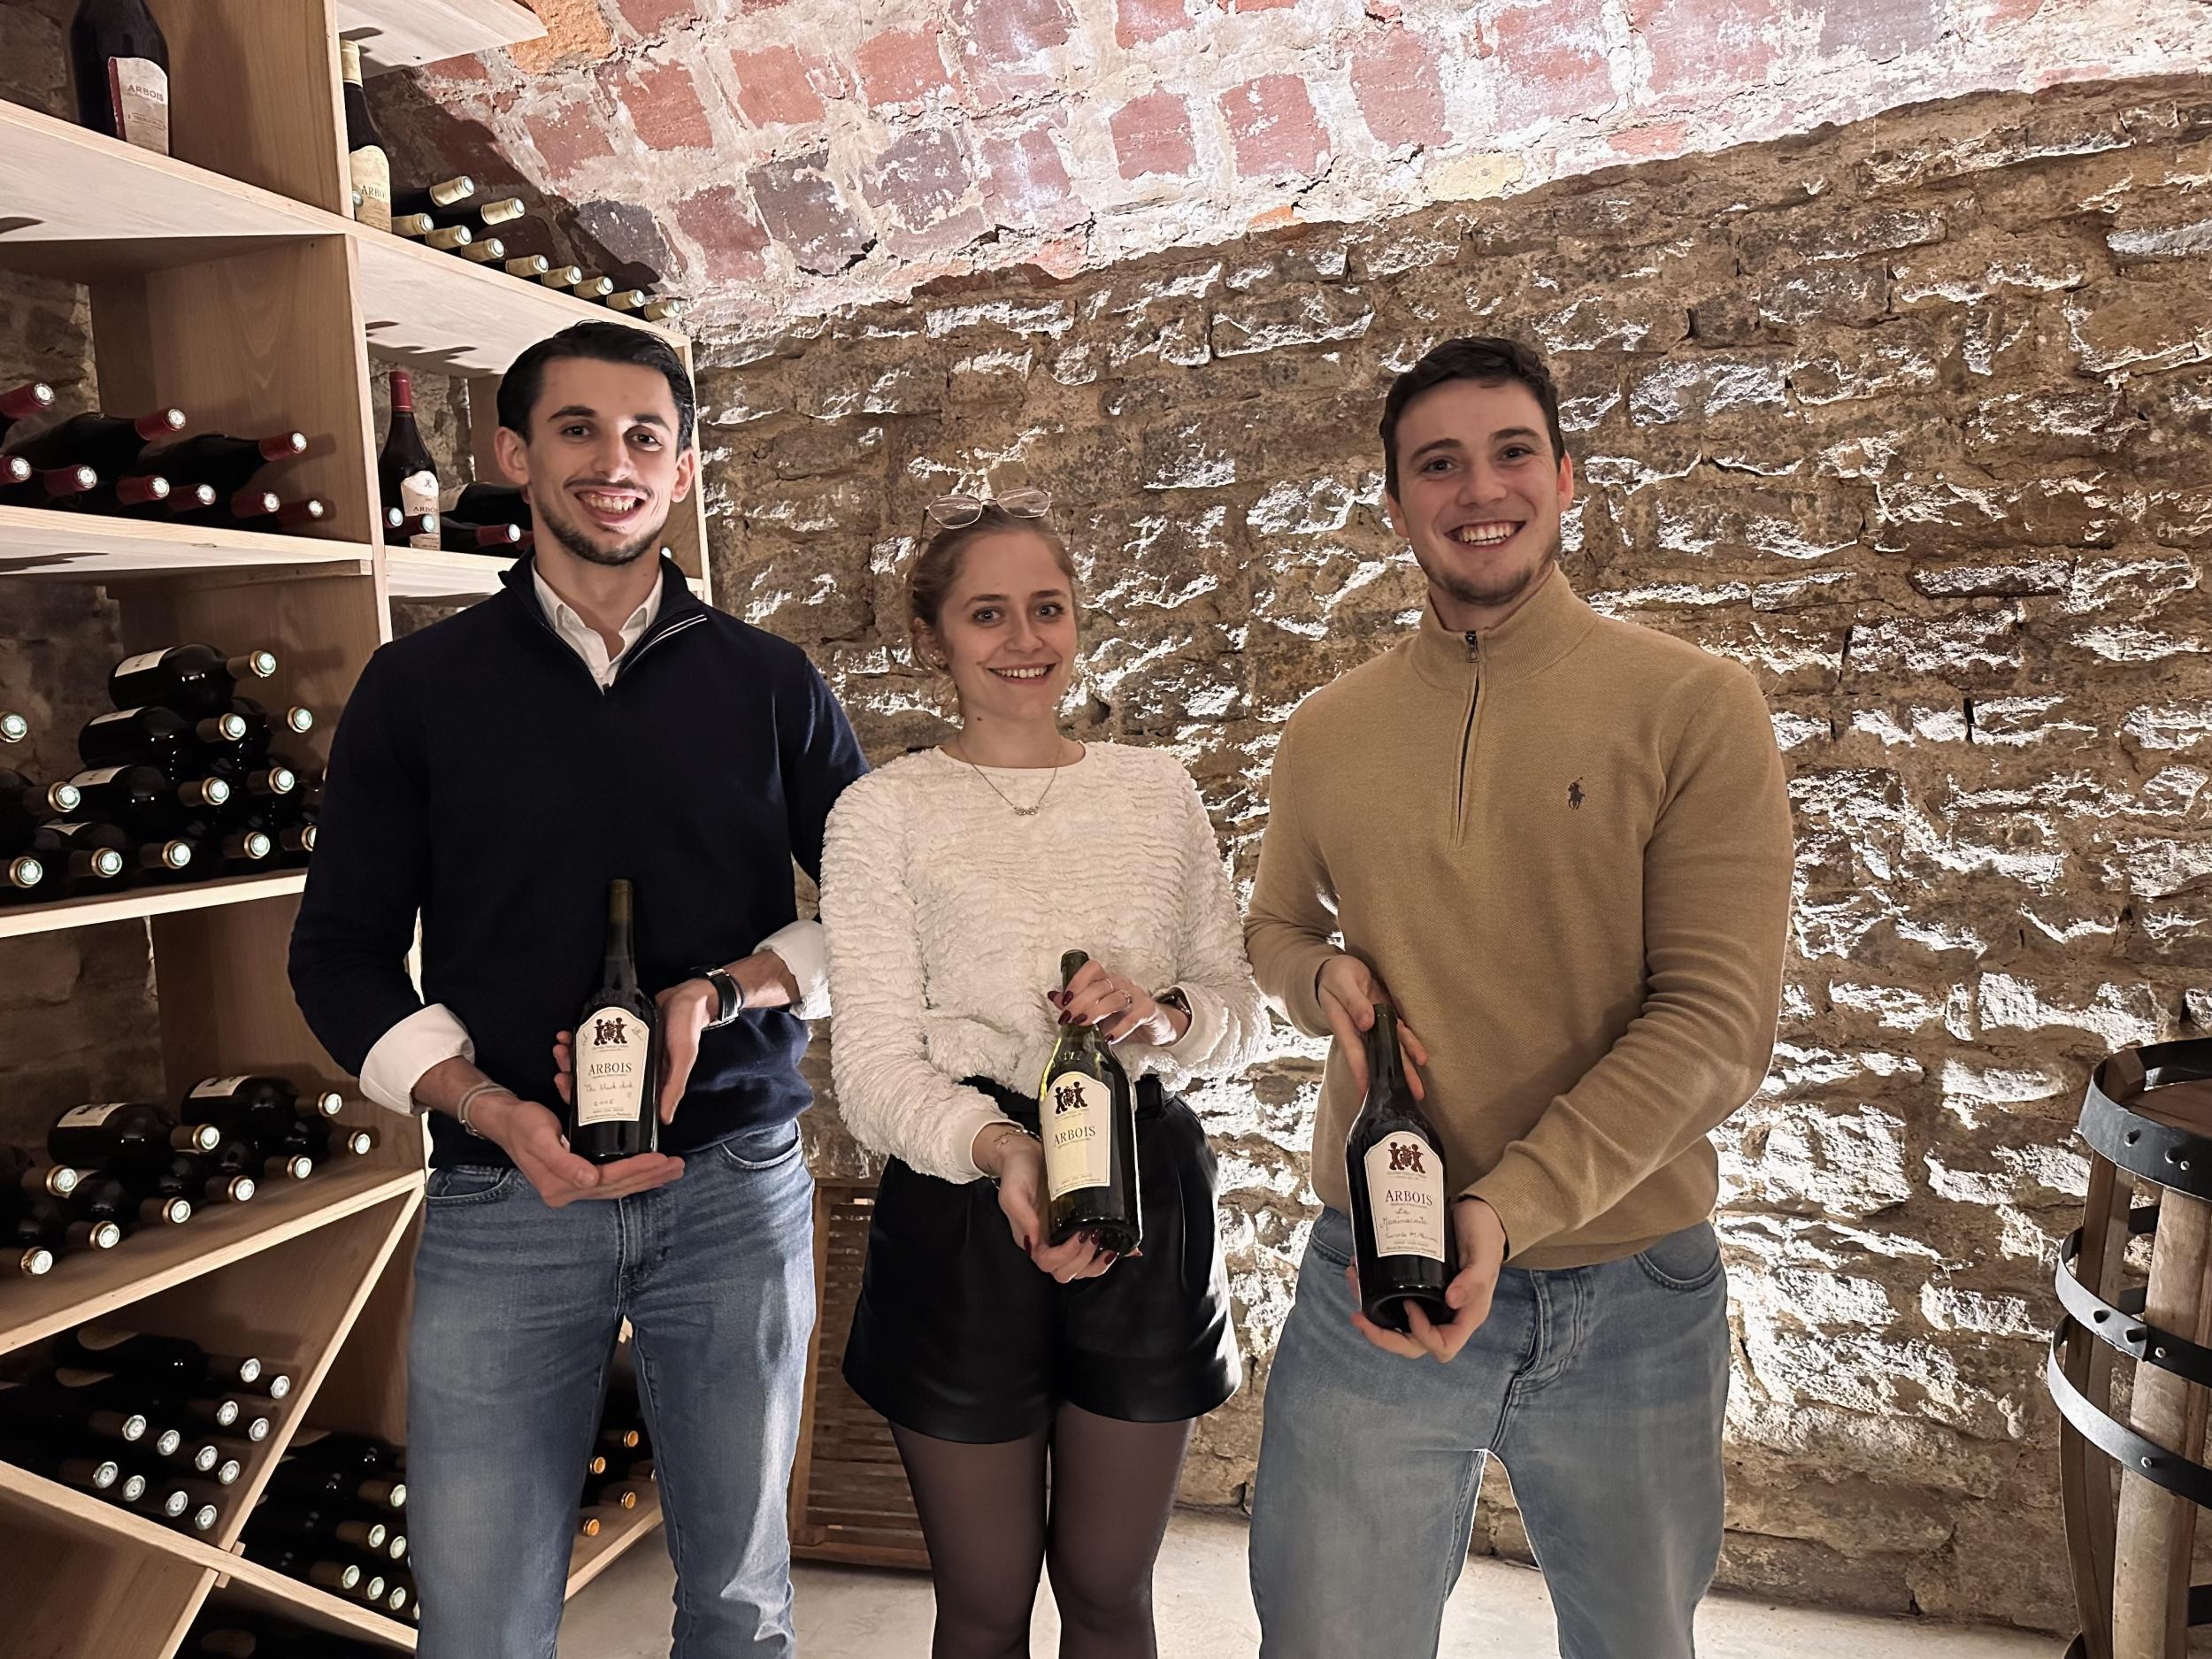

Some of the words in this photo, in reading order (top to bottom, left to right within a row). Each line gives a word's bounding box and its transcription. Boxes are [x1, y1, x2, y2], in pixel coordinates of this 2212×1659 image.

[127, 84, 165, 102] ARBOIS
[588, 1062, 633, 1077] ARBOIS
[1053, 1125, 1097, 1148] ARBOIS
[1386, 1189, 1432, 1206] ARBOIS
